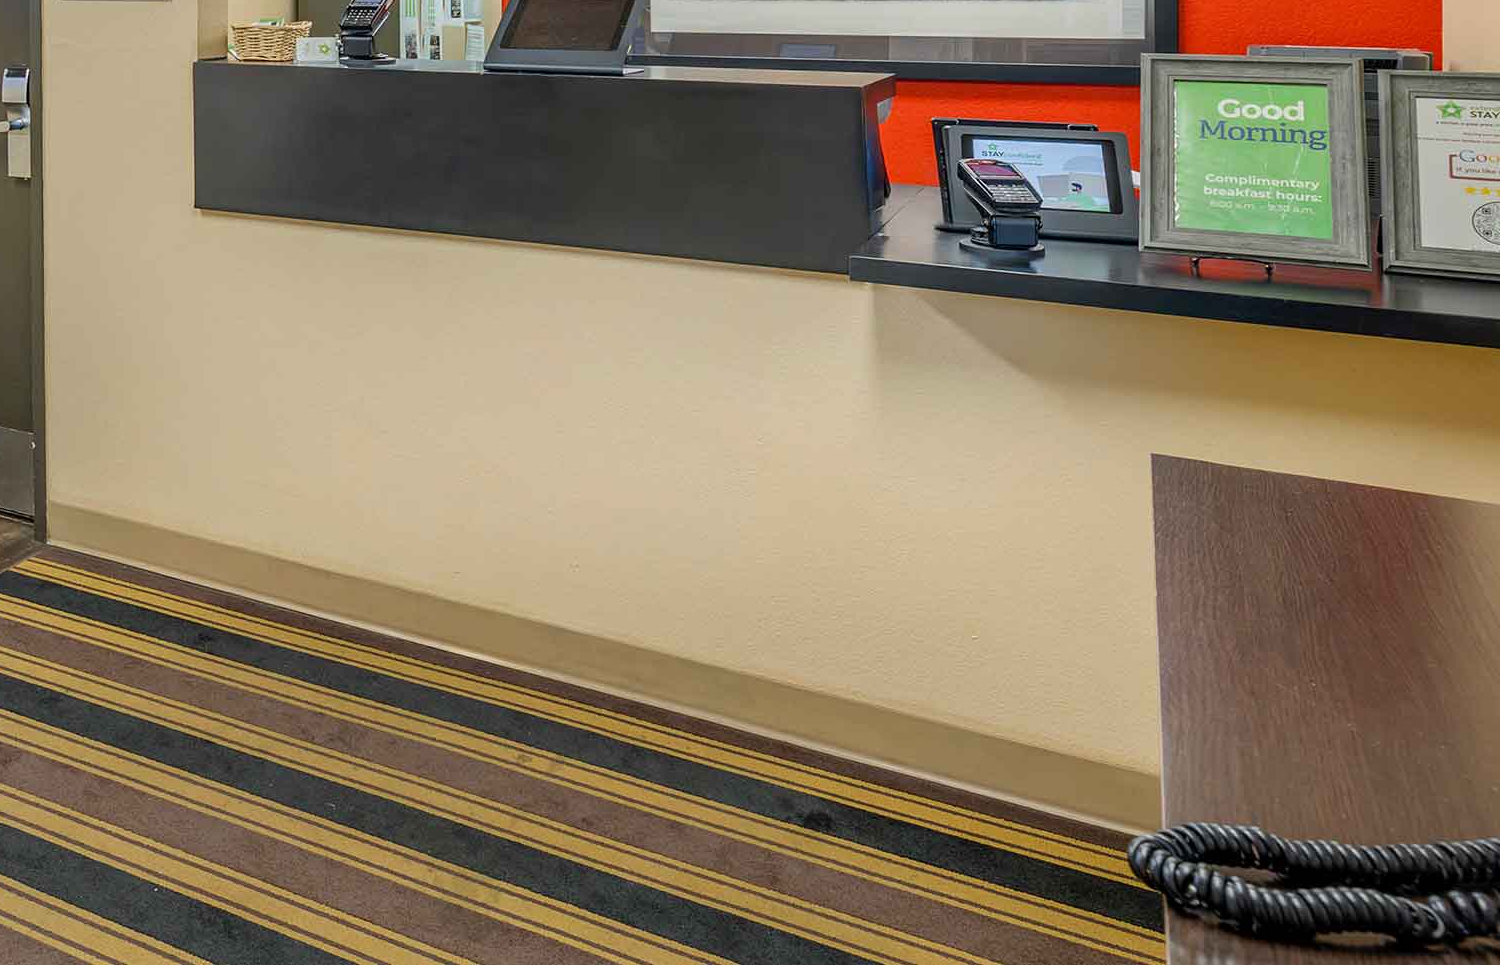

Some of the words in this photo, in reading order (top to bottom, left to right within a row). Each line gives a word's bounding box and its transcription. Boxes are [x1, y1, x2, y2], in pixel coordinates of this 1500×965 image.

[1217, 98, 1304, 121] Good
[1470, 111, 1500, 119] STAY
[1199, 118, 1328, 151] Morning
[1204, 173, 1320, 191] Complimentary
[1204, 185, 1271, 200] breakfast
[1275, 190, 1323, 203] hours:
